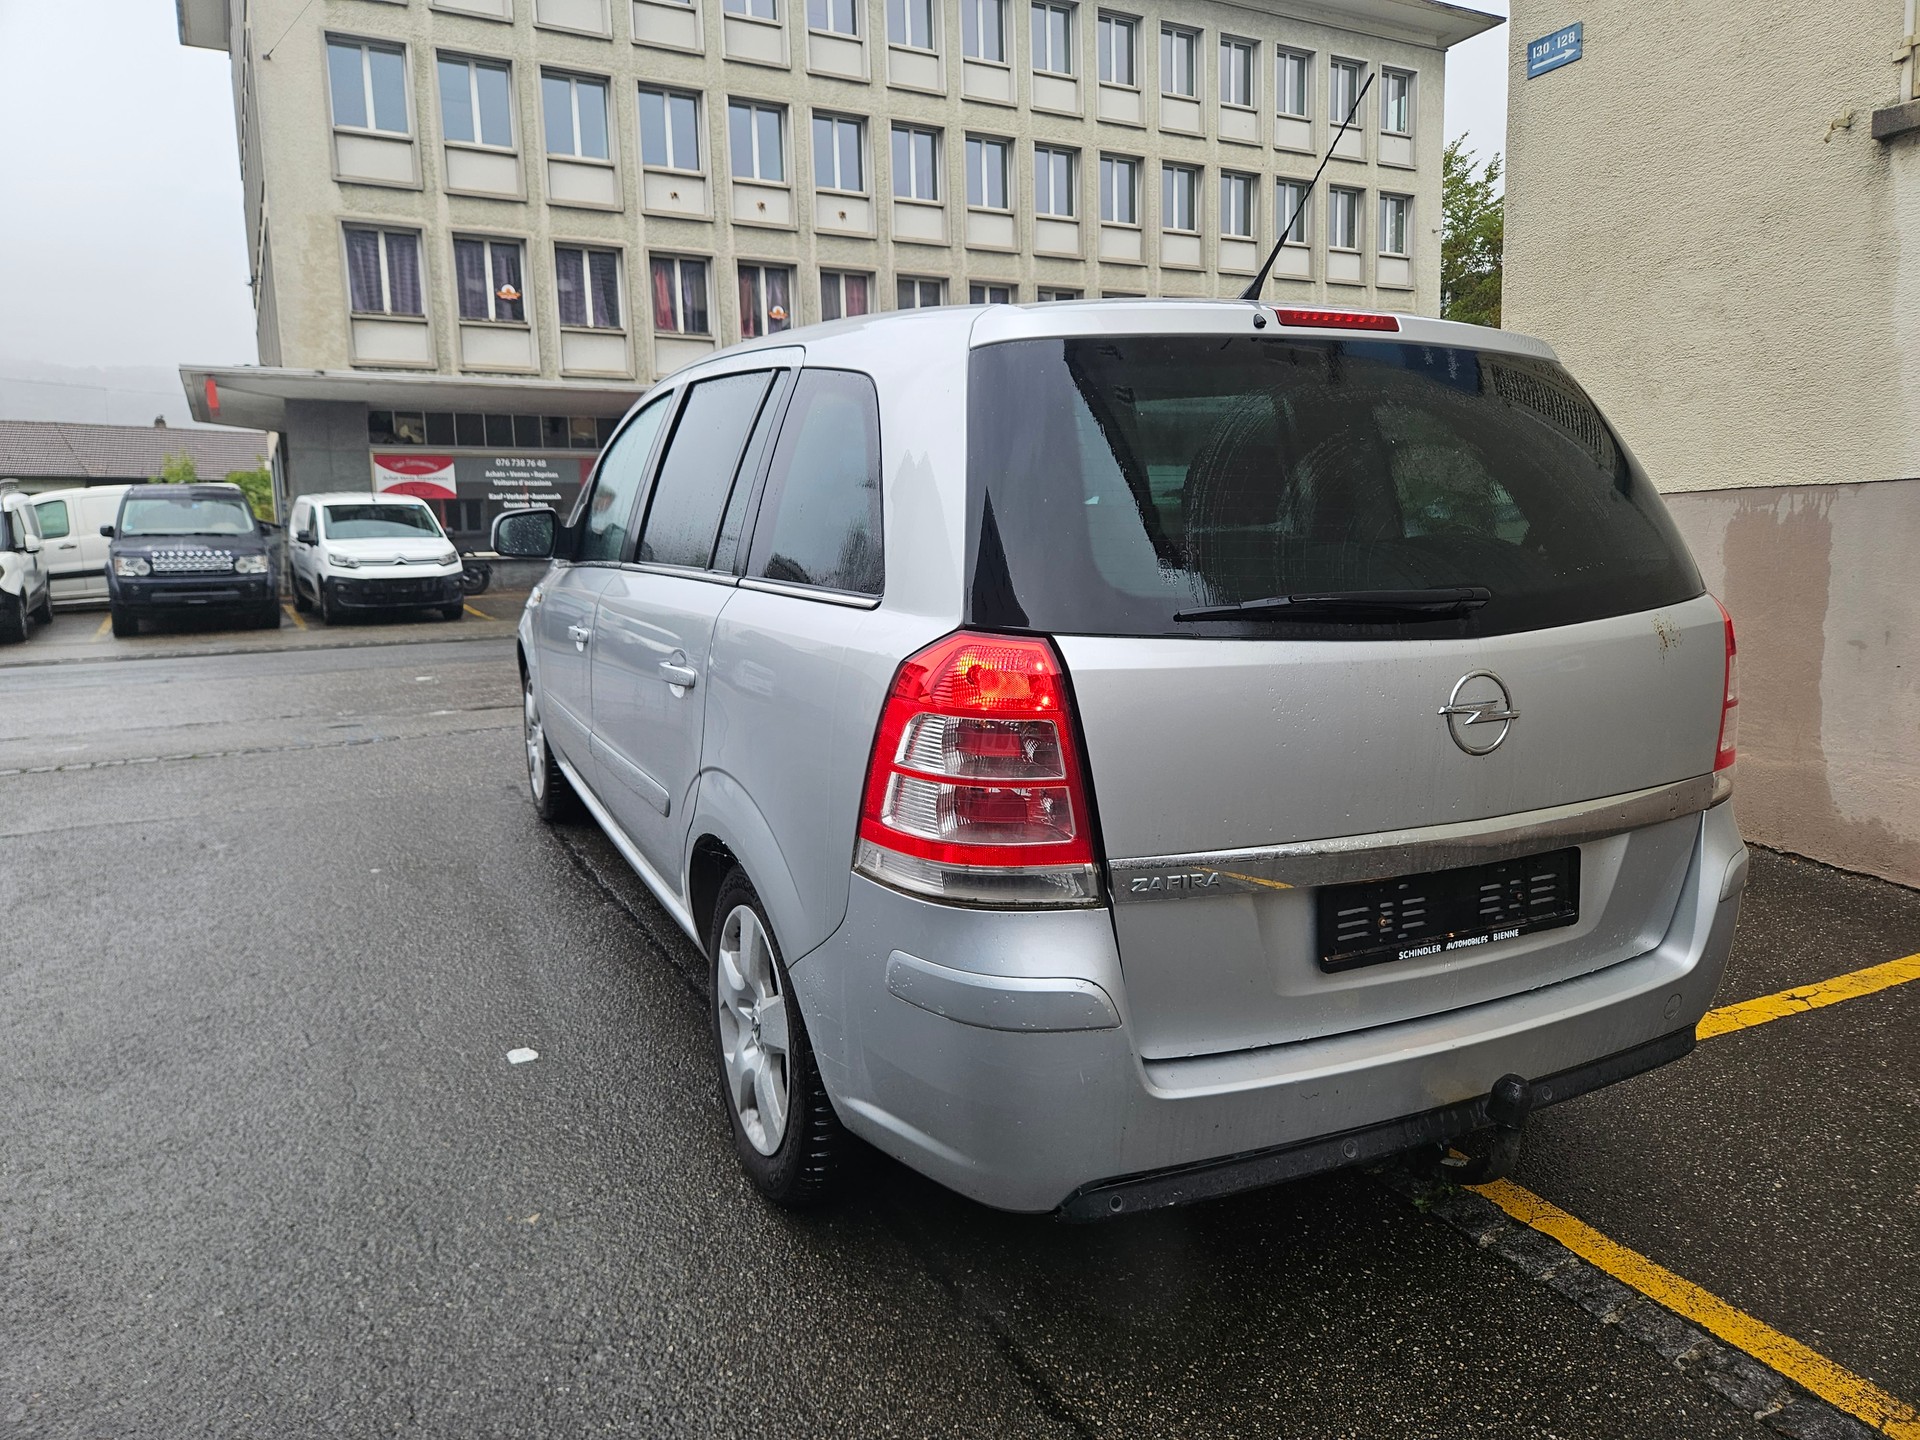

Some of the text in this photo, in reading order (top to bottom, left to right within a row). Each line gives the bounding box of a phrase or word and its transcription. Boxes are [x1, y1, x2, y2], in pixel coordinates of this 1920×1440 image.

[1533, 31, 1575, 58] 130 128
[495, 458, 547, 468] 076 738 76 48
[485, 470, 559, 479] Achats Ventes Reprises
[1131, 872, 1220, 893] ZAFIRA
[1398, 929, 1519, 960] SCHINDLER AUTOMOBILES BIENNE
